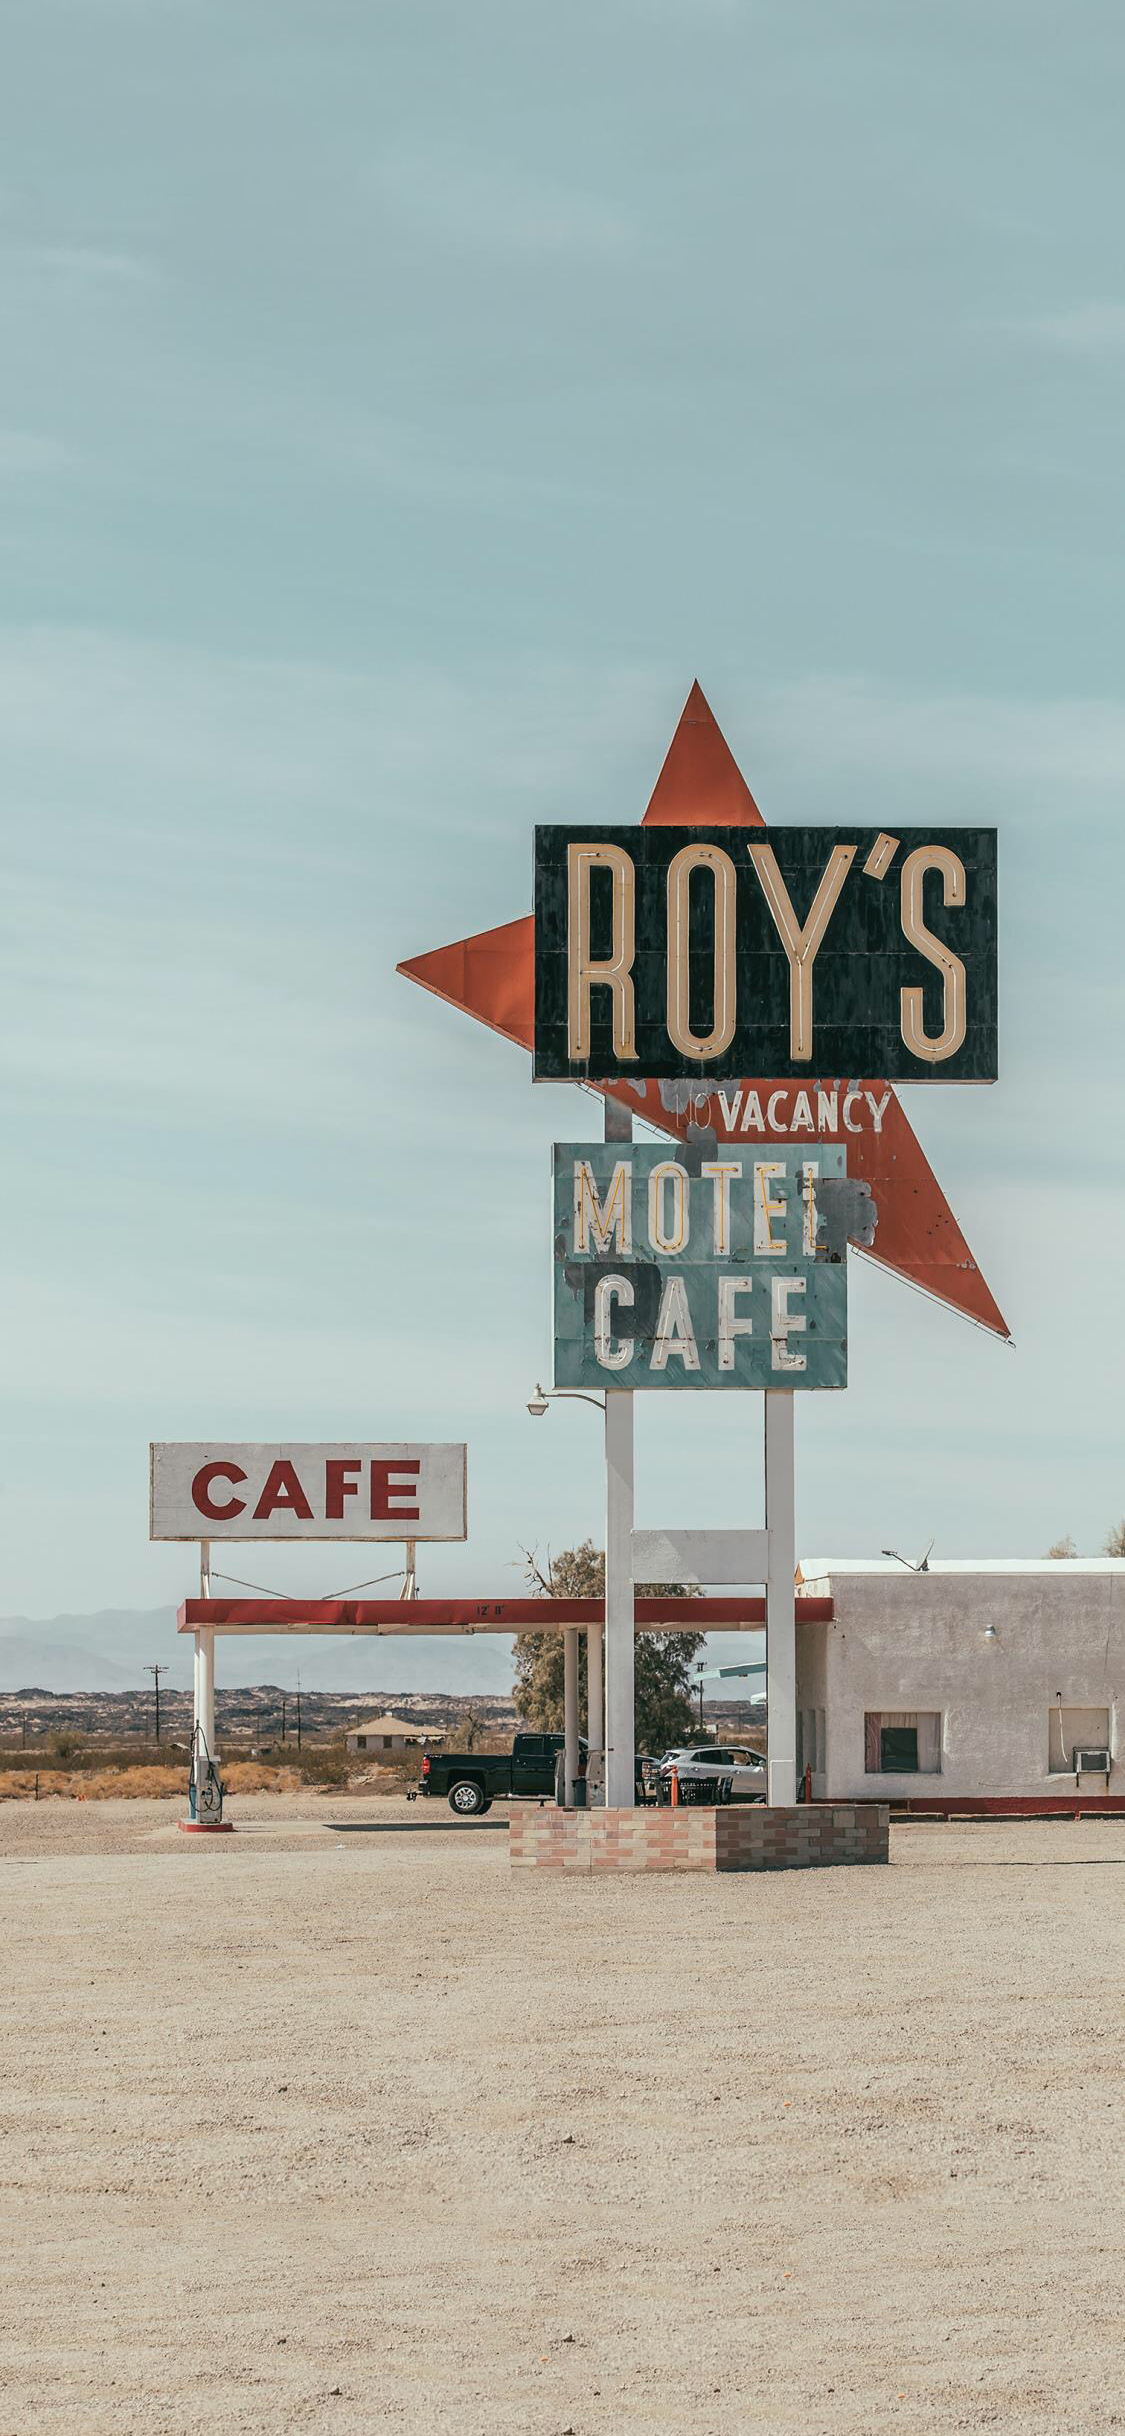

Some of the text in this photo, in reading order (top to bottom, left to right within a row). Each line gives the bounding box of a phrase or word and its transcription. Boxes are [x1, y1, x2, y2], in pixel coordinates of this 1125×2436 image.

[567, 833, 967, 1062] ROY'S
[717, 1090, 893, 1133] VACANCY
[573, 1160, 829, 1256] MOTEL
[594, 1274, 807, 1371] CAFE
[191, 1460, 421, 1521] CAFE
